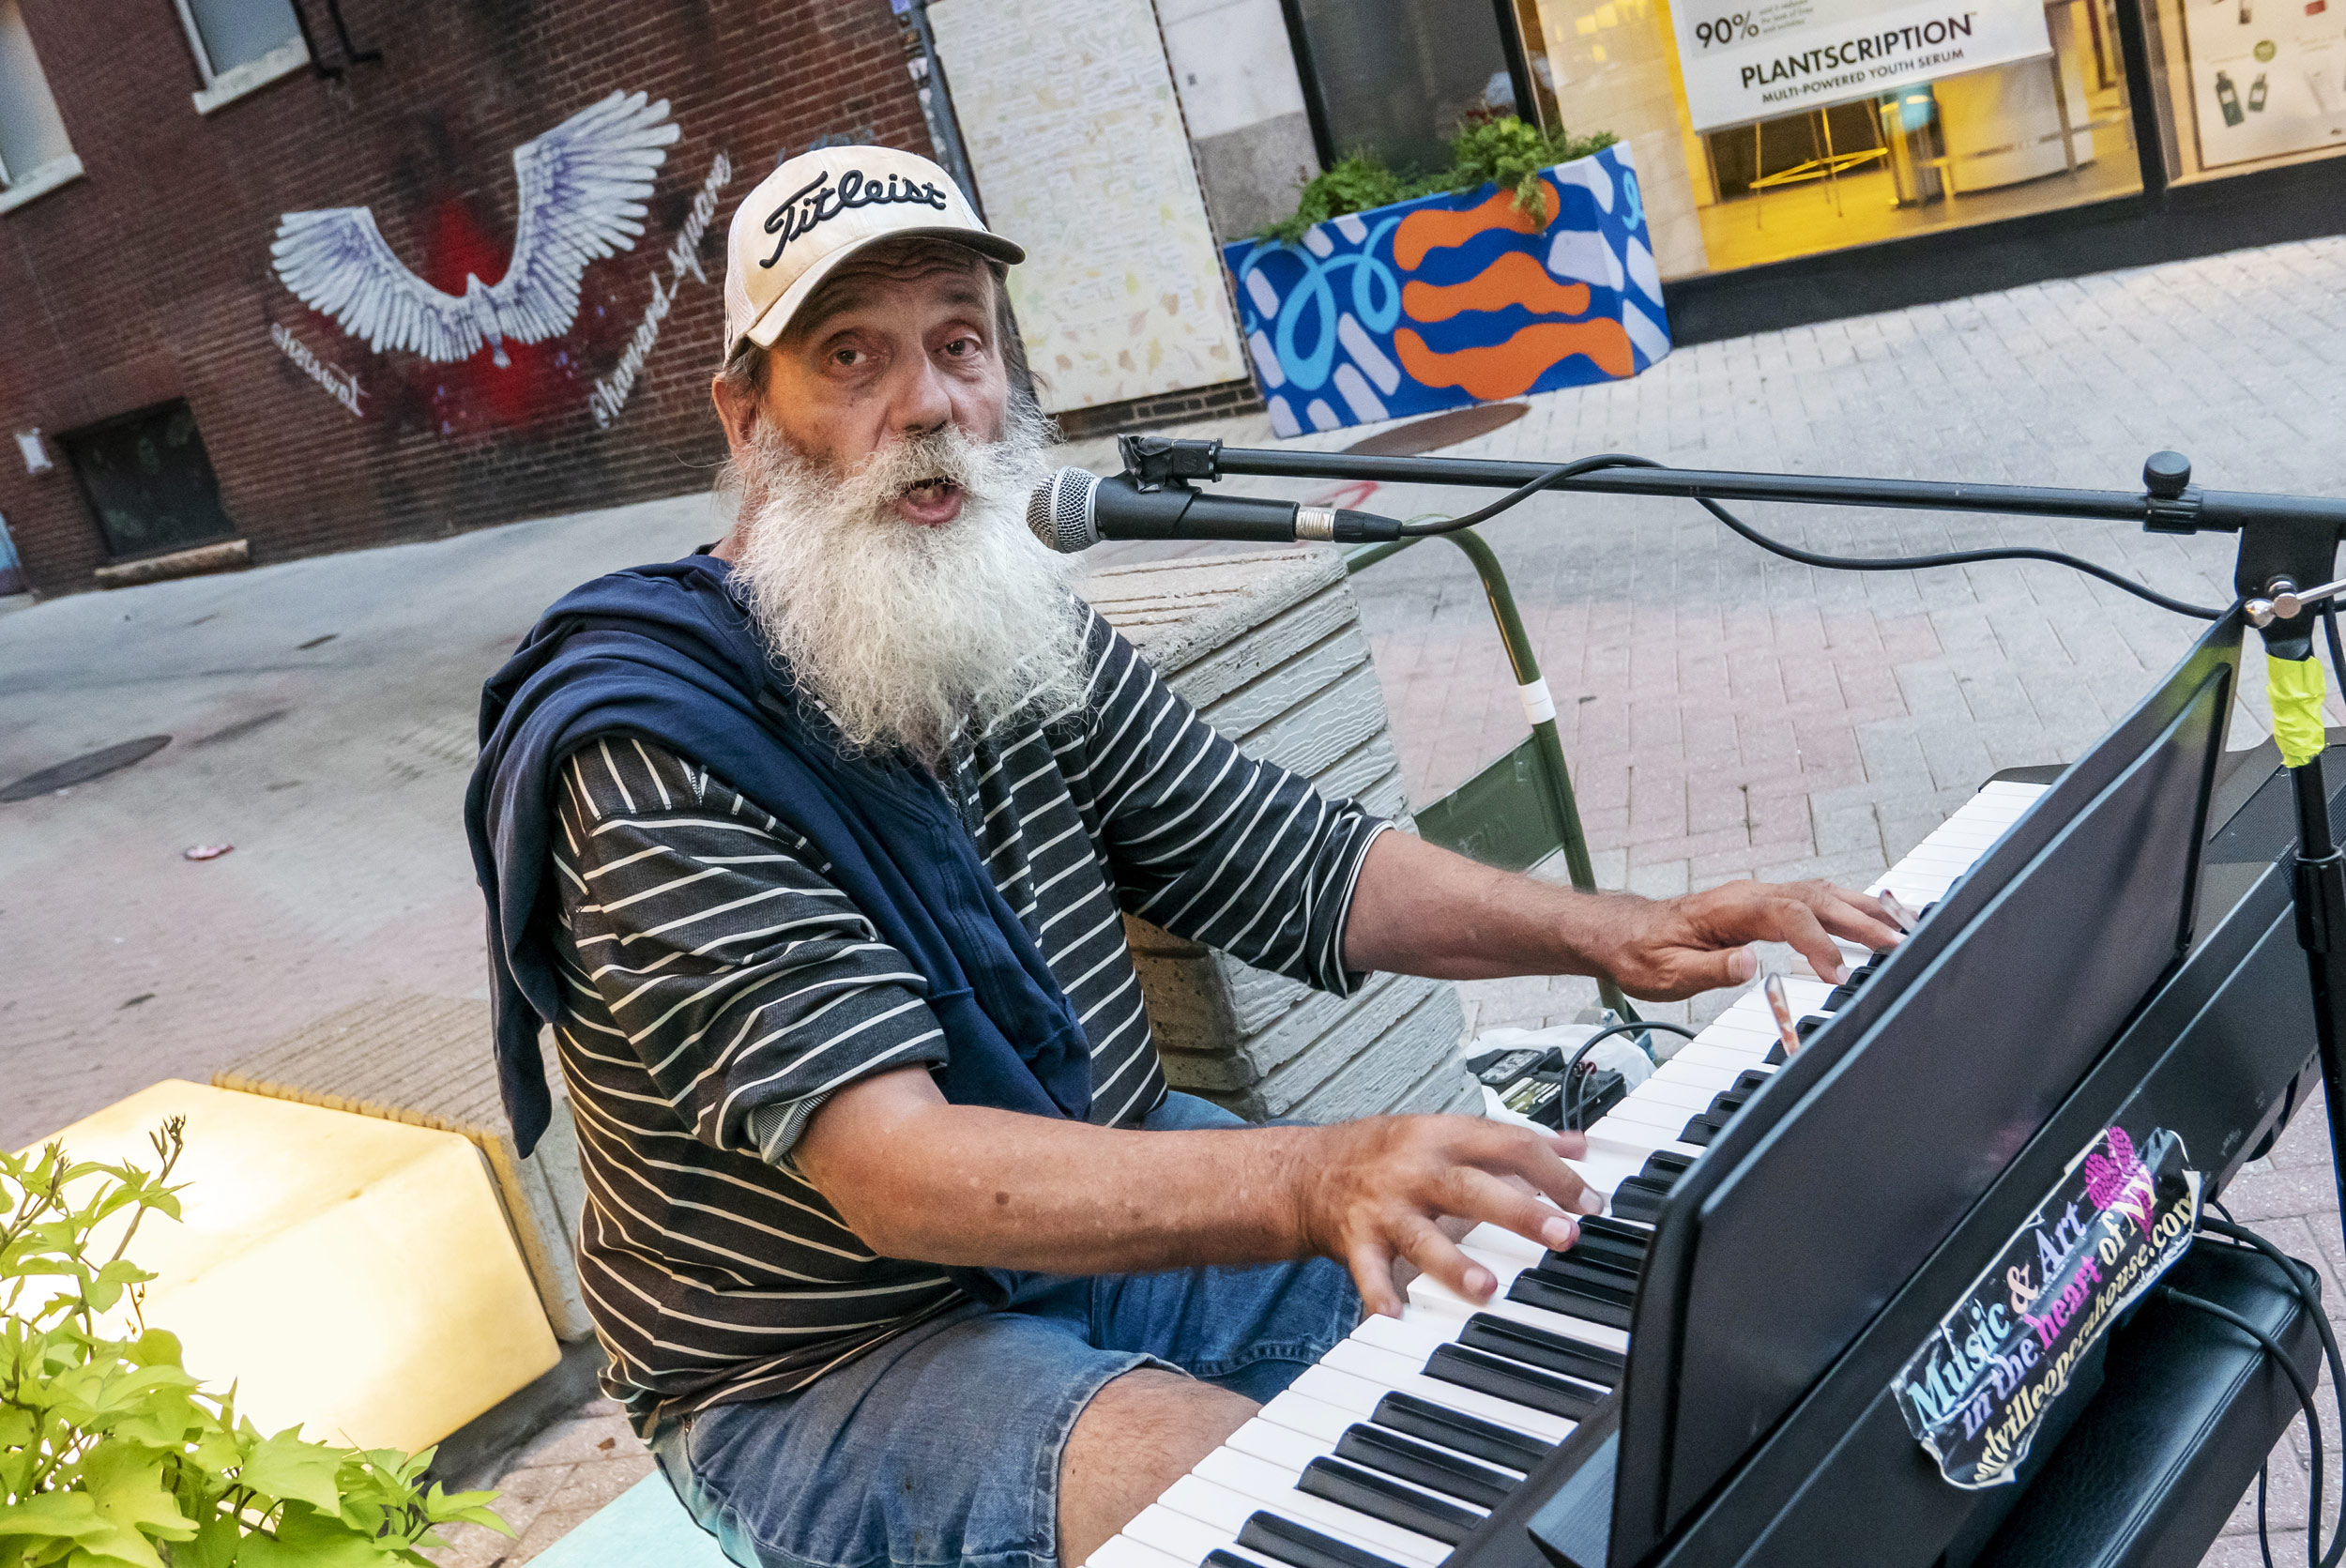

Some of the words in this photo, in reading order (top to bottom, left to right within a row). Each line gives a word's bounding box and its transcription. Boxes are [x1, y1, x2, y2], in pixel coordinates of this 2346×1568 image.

[1696, 10, 1760, 48] 90%
[1762, 70, 1866, 103] MULTI-POWERED
[1868, 59, 1915, 80] YOUTH
[1918, 49, 1965, 69] SERUM
[759, 169, 947, 268] Titleist
[2110, 1164, 2158, 1236] NY
[2098, 1212, 2126, 1266] of
[1906, 1302, 2010, 1430] Music
[2006, 1263, 2038, 1314] &
[2035, 1201, 2086, 1283] Art
[2024, 1256, 2102, 1350] heart
[1991, 1338, 2039, 1400] the
[1962, 1392, 1994, 1441] in
